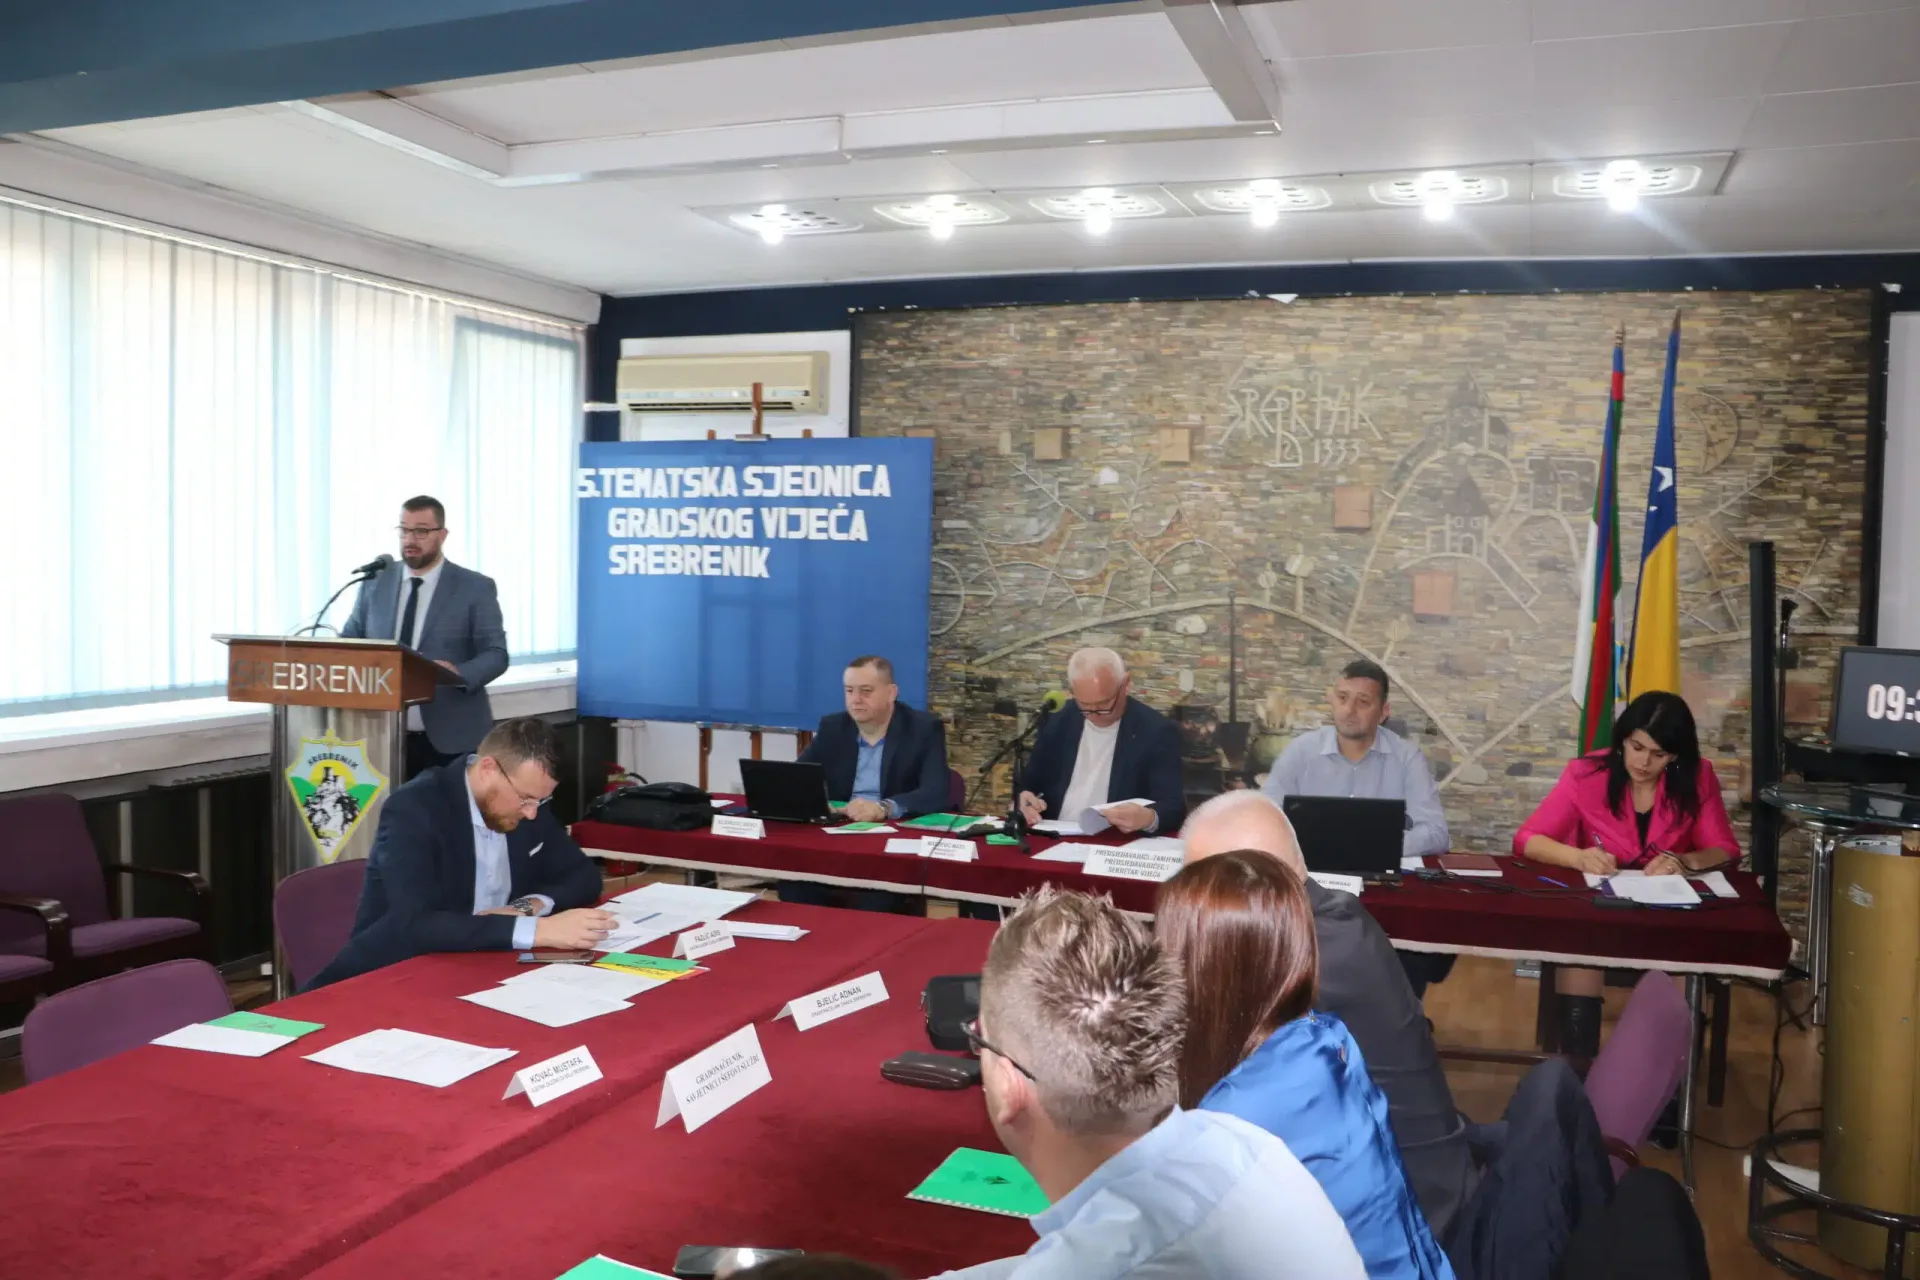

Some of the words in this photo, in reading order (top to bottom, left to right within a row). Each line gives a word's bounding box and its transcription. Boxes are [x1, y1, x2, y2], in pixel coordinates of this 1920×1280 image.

[743, 464, 892, 498] SJEDNICA
[608, 506, 754, 539] GRADSKOG
[608, 544, 771, 578] SREBRENIK
[233, 659, 394, 696] SREBRENIK
[839, 985, 862, 999] ADNAN
[552, 1056, 583, 1075] MUSTAFA
